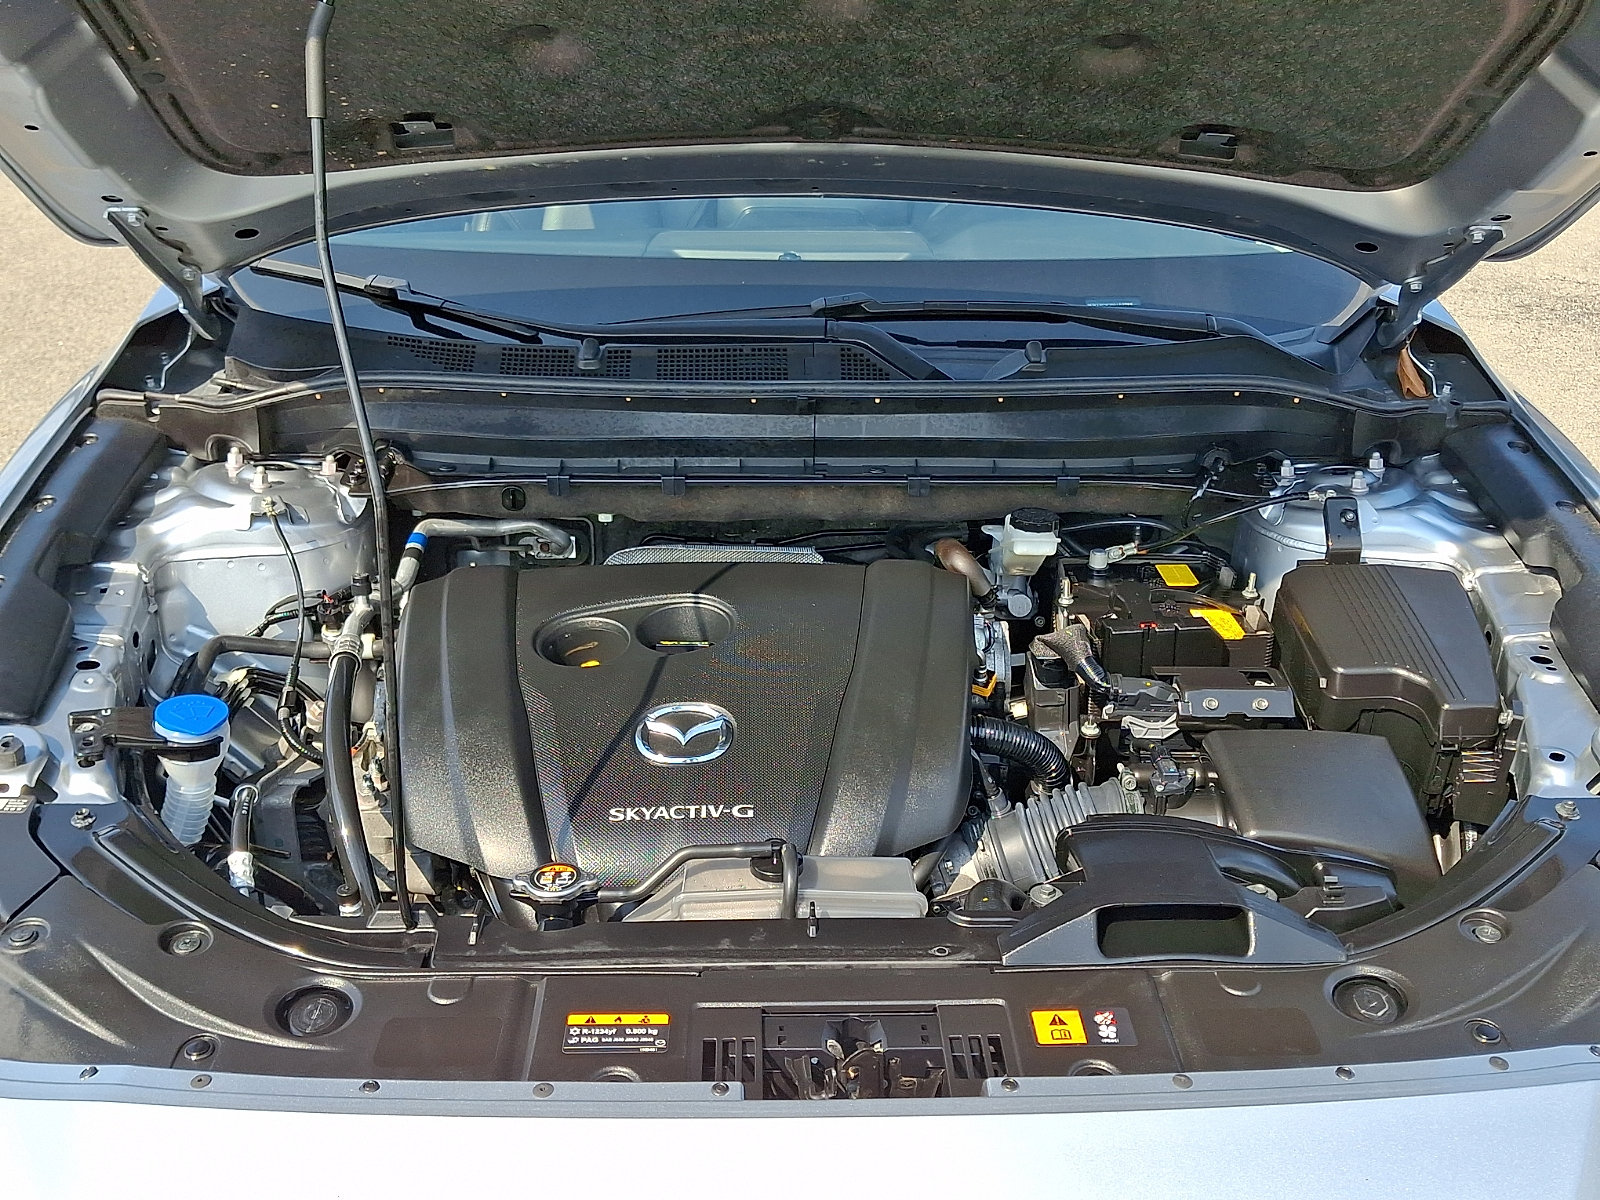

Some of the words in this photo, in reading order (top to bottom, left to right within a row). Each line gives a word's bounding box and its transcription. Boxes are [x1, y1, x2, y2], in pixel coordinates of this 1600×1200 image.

[608, 804, 754, 822] SKYACTIV-G
[581, 1028, 617, 1036] R-1234yf
[647, 1028, 659, 1036] kg
